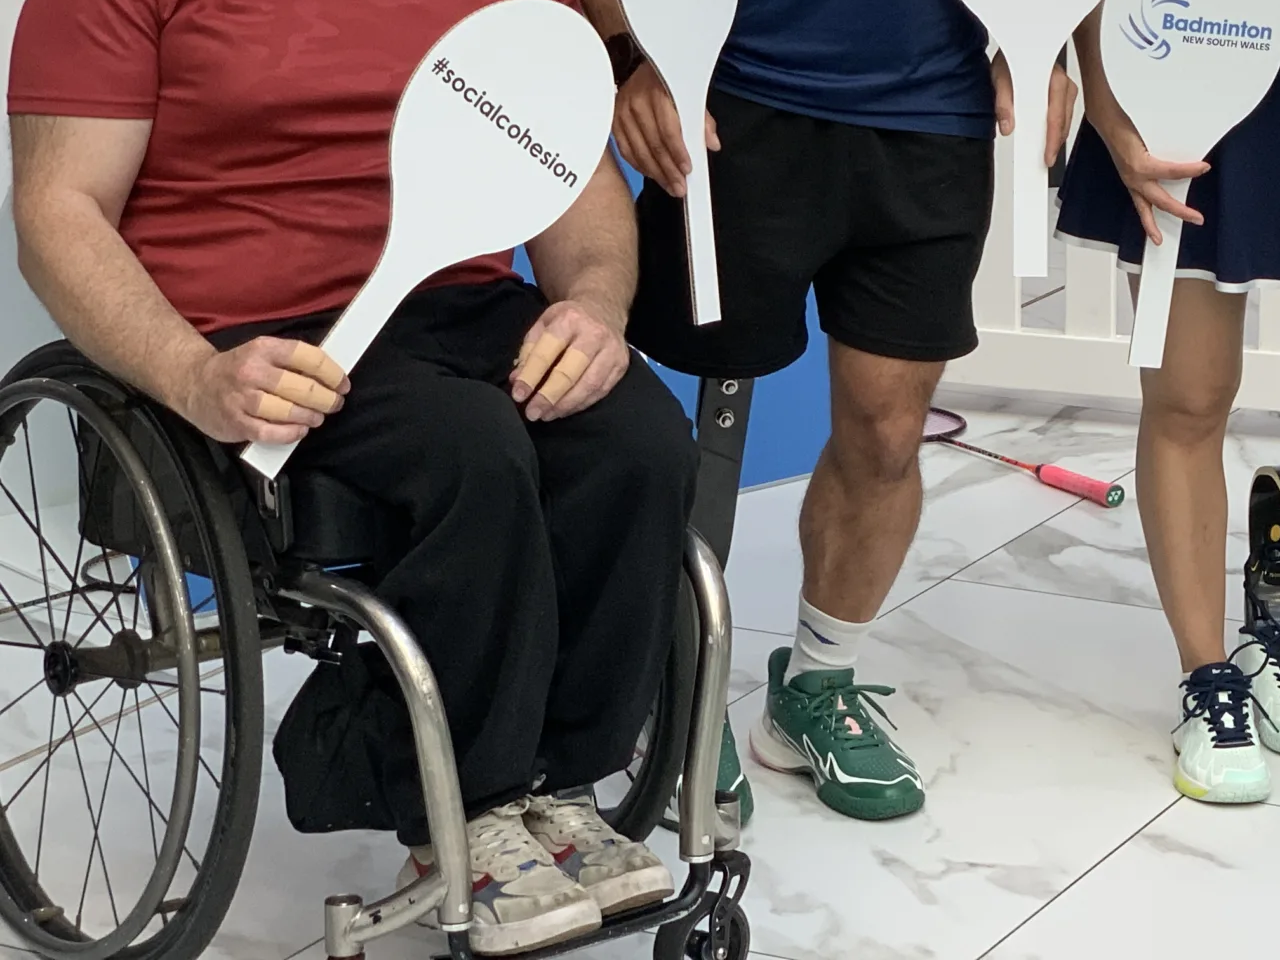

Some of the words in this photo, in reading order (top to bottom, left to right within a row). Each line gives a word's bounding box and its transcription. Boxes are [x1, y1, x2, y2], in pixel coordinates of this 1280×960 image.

[1161, 12, 1273, 41] Badminton
[1181, 35, 1205, 45] NEW
[1206, 36, 1239, 49] SOUTH
[1240, 40, 1271, 52] WALES
[431, 57, 578, 188] #socialcohesion
